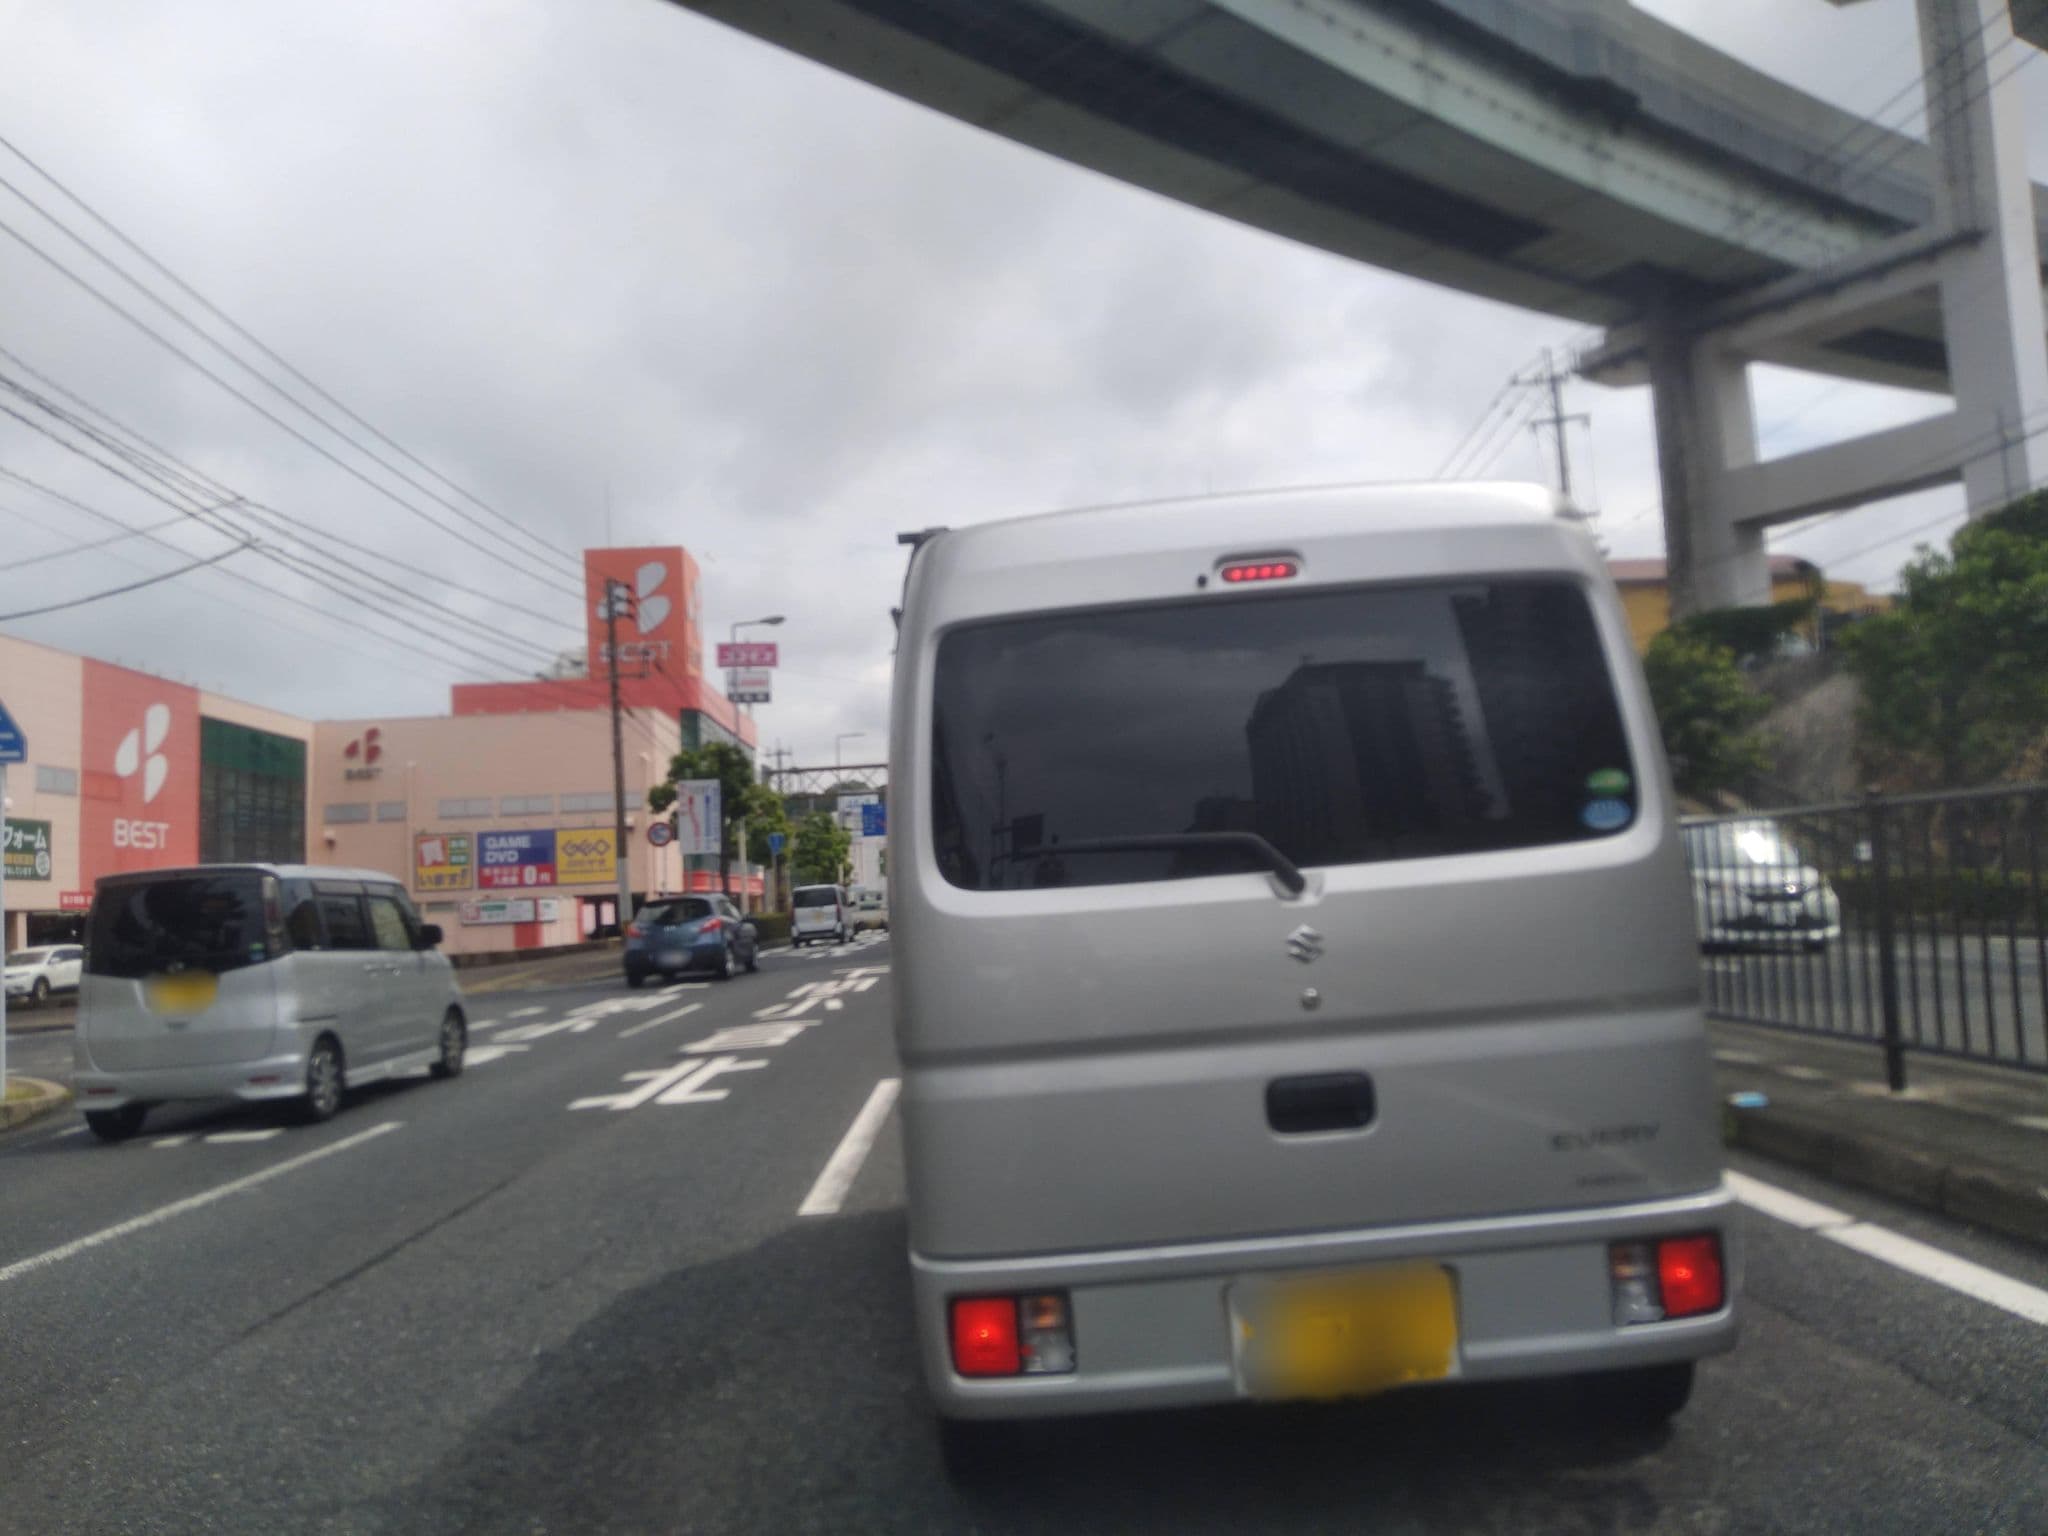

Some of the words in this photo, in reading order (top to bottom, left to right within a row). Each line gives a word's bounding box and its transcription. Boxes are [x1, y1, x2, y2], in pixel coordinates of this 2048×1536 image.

[113, 817, 169, 849] BEST
[485, 835, 531, 849] GAME
[485, 850, 519, 864] DVD
